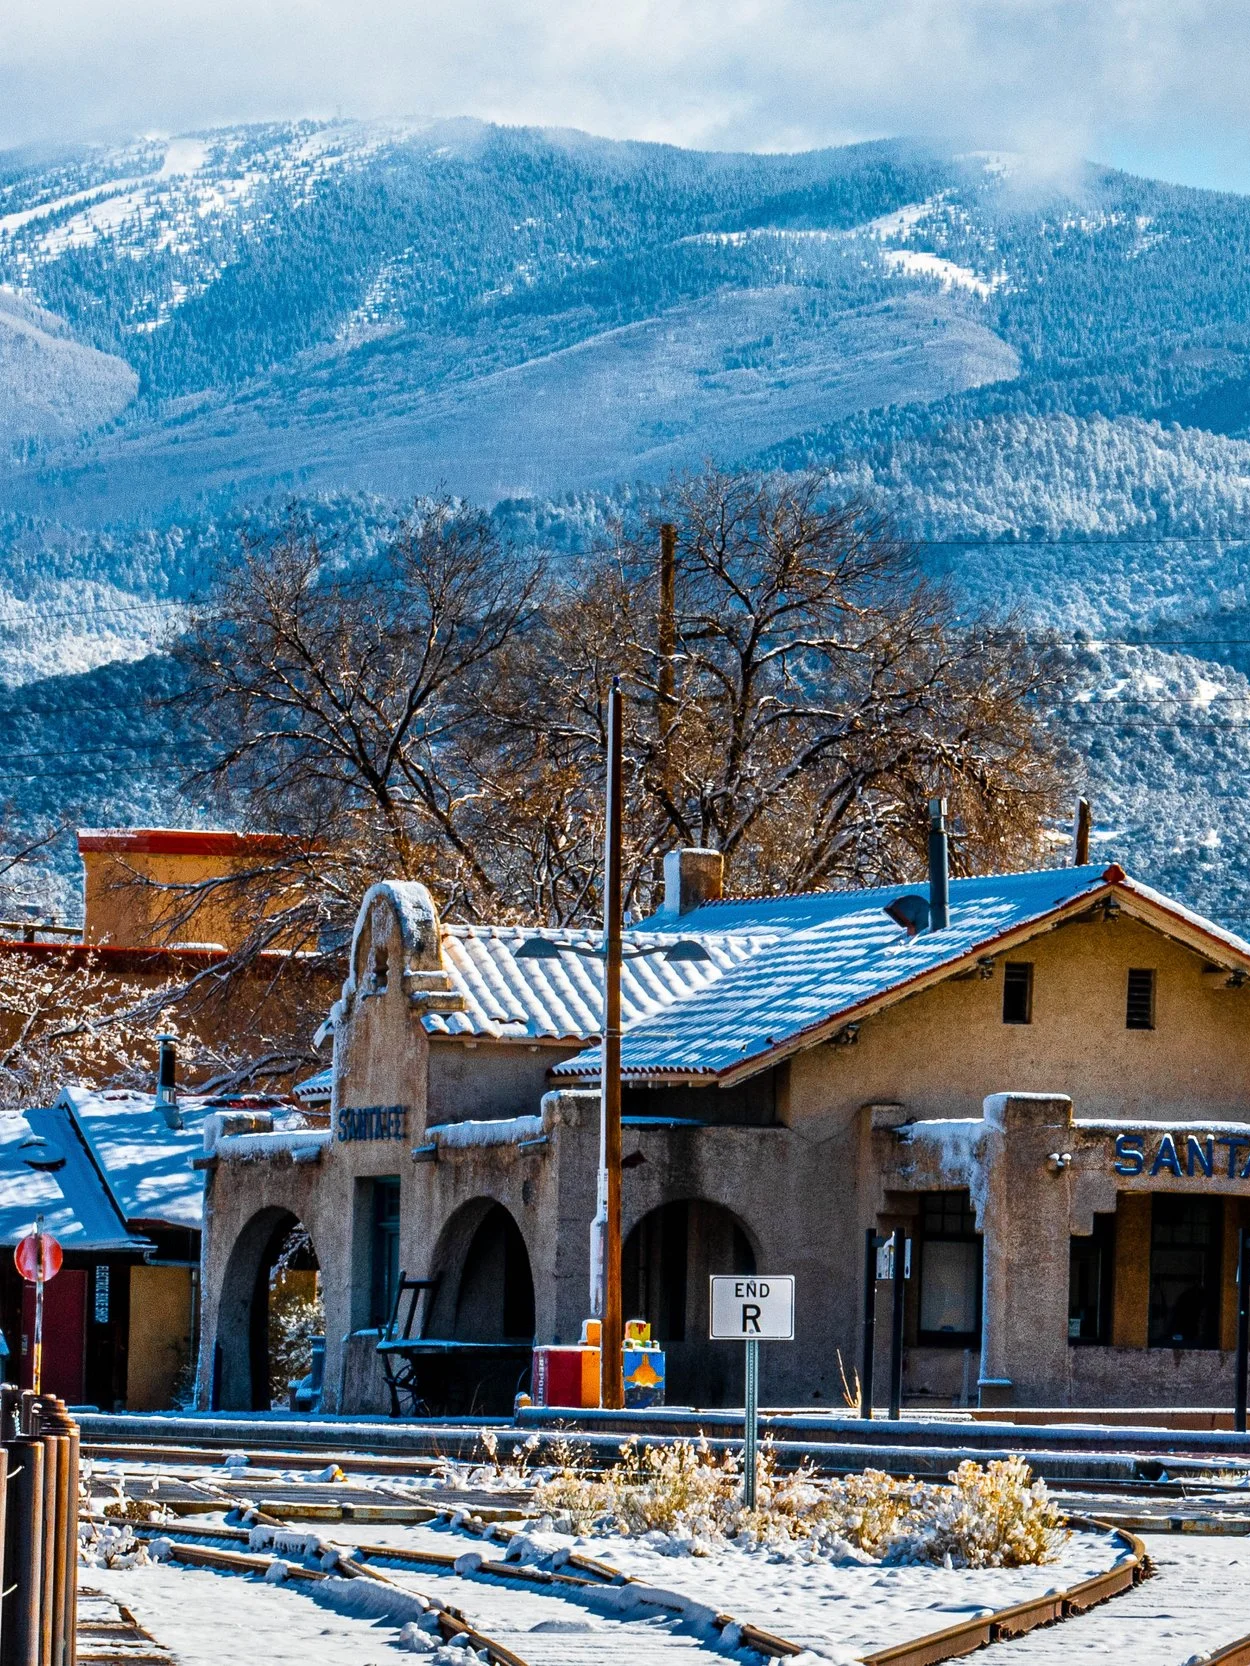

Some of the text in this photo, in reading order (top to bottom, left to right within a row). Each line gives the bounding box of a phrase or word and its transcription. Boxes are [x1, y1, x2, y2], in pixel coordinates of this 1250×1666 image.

[338, 1104, 407, 1141] SANTA FE
[95, 1265, 109, 1323] ELECTRIC BIKE SHOP
[735, 1283, 770, 1298] END
[742, 1304, 761, 1333] R
